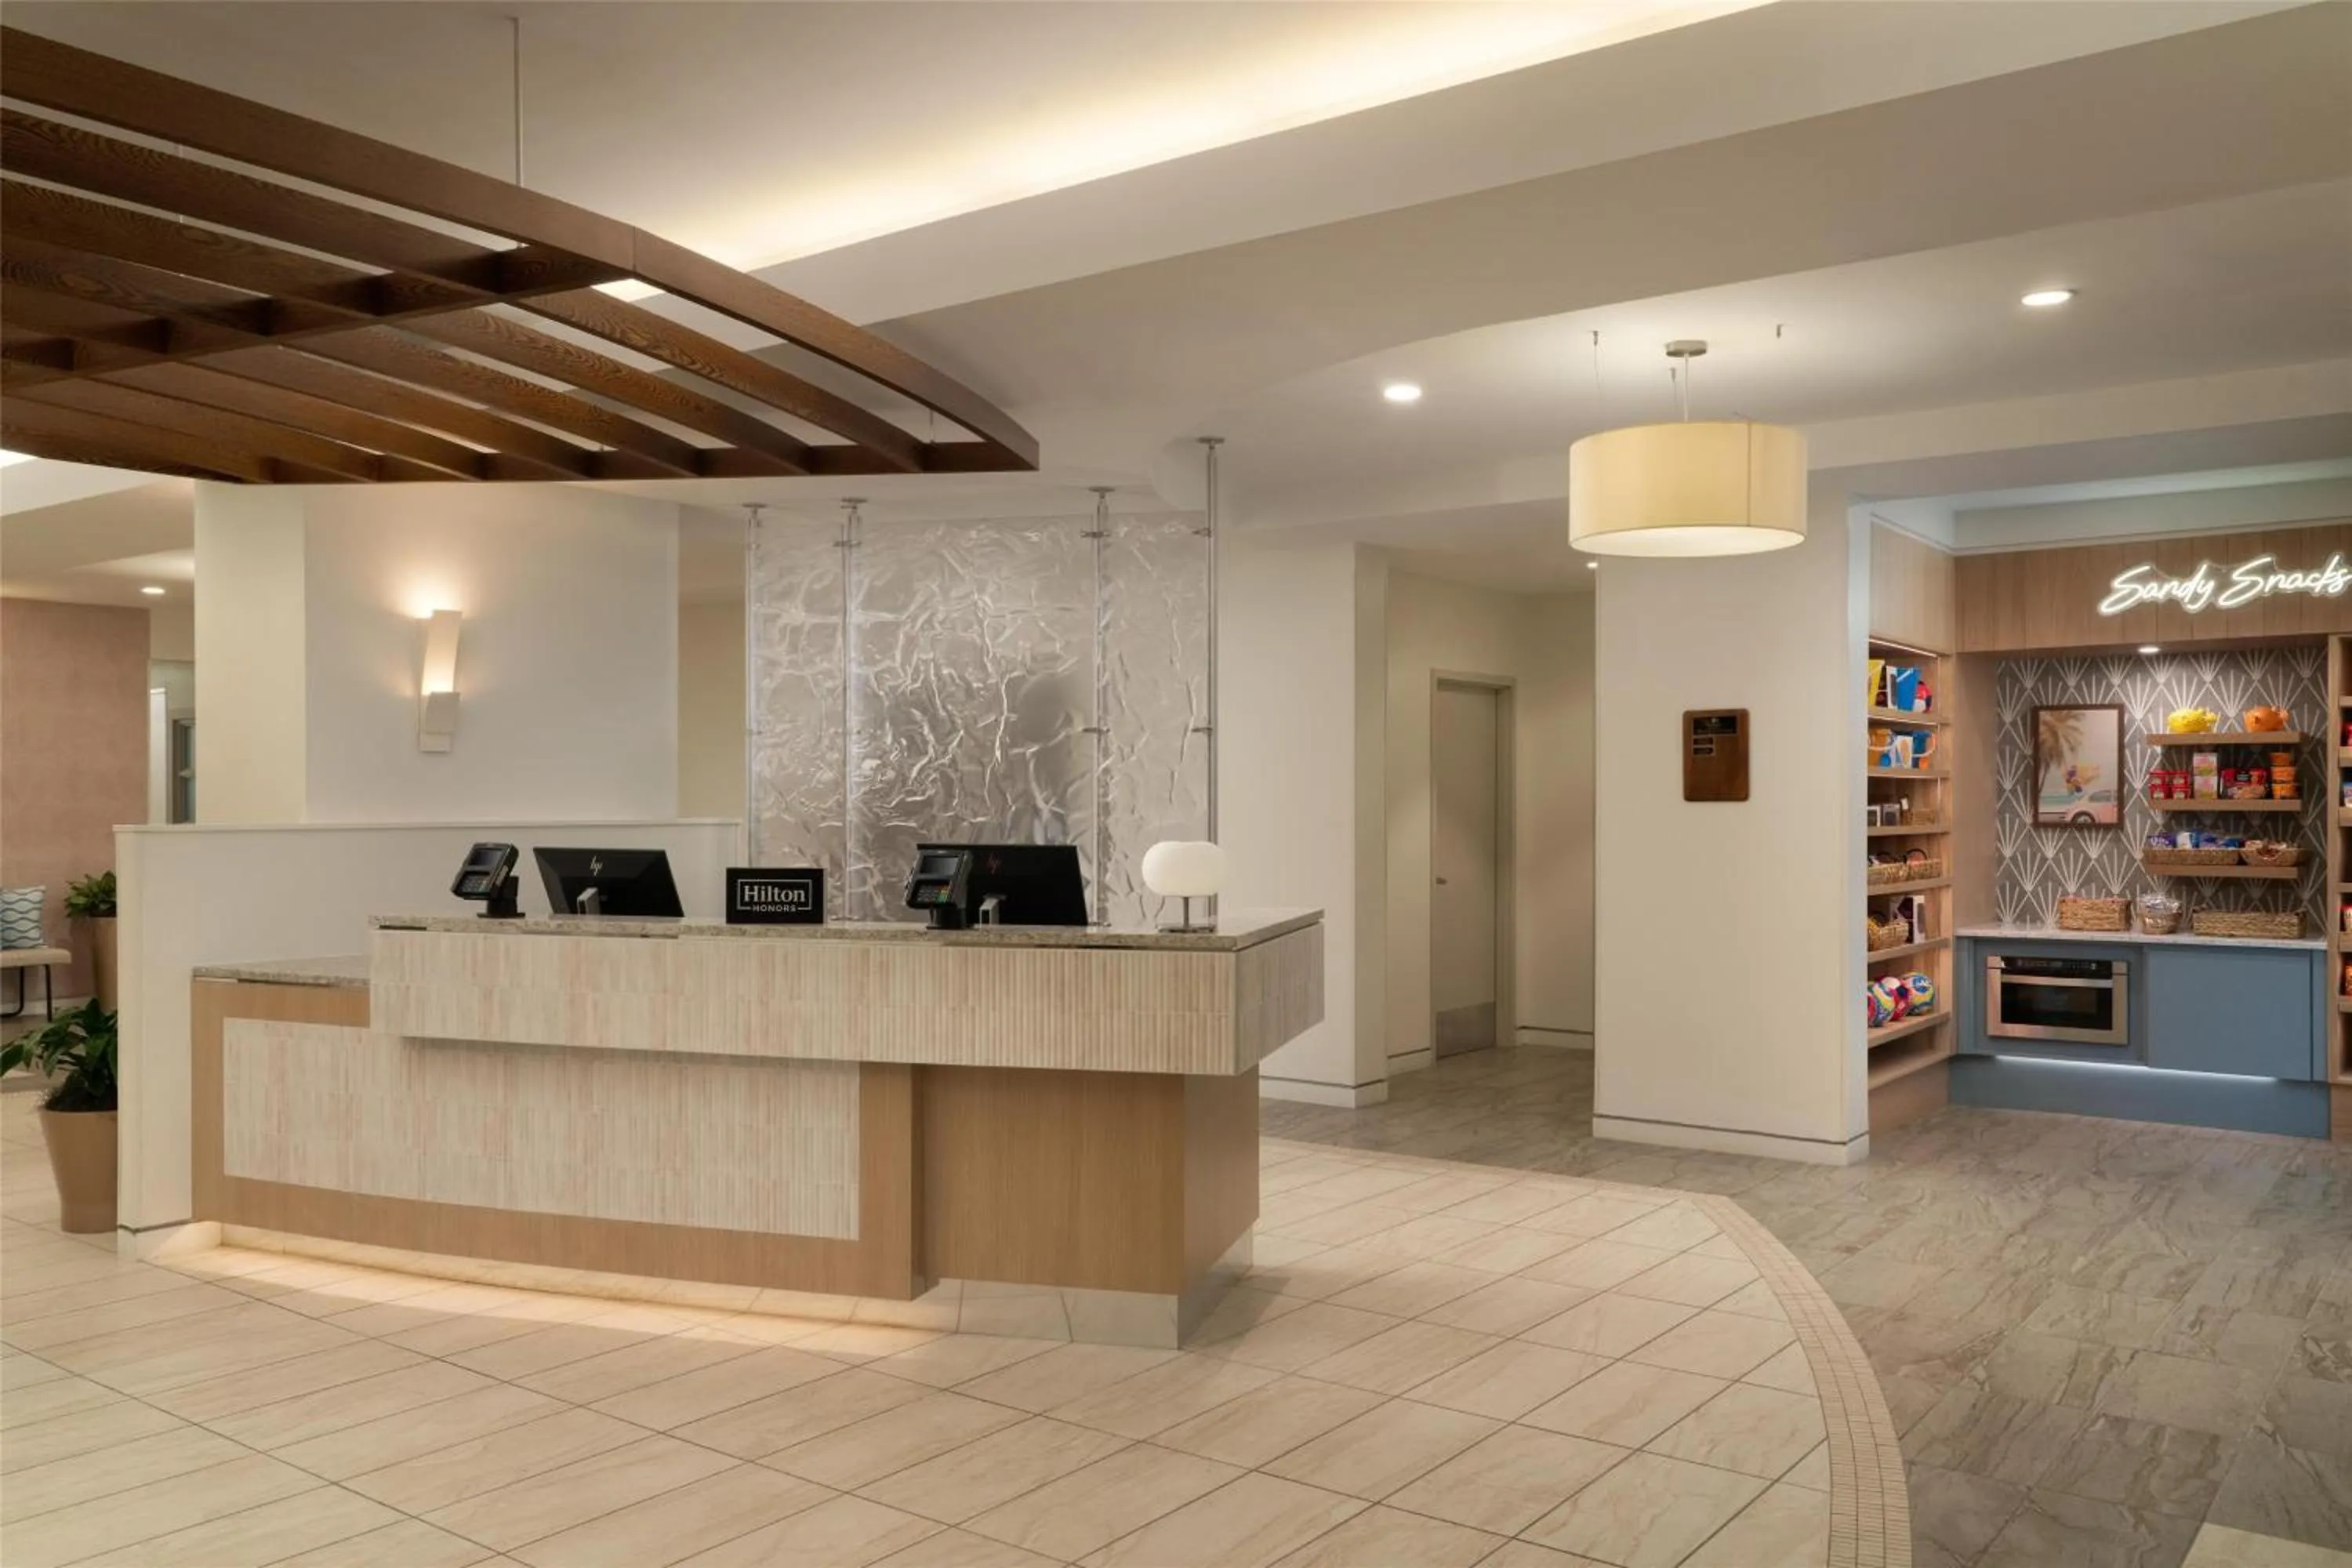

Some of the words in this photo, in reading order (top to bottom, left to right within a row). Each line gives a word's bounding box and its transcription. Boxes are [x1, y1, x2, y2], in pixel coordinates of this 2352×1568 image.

[2099, 563, 2216, 613] Sandy
[2217, 554, 2352, 608] Snacks
[743, 884, 806, 902] Hilton
